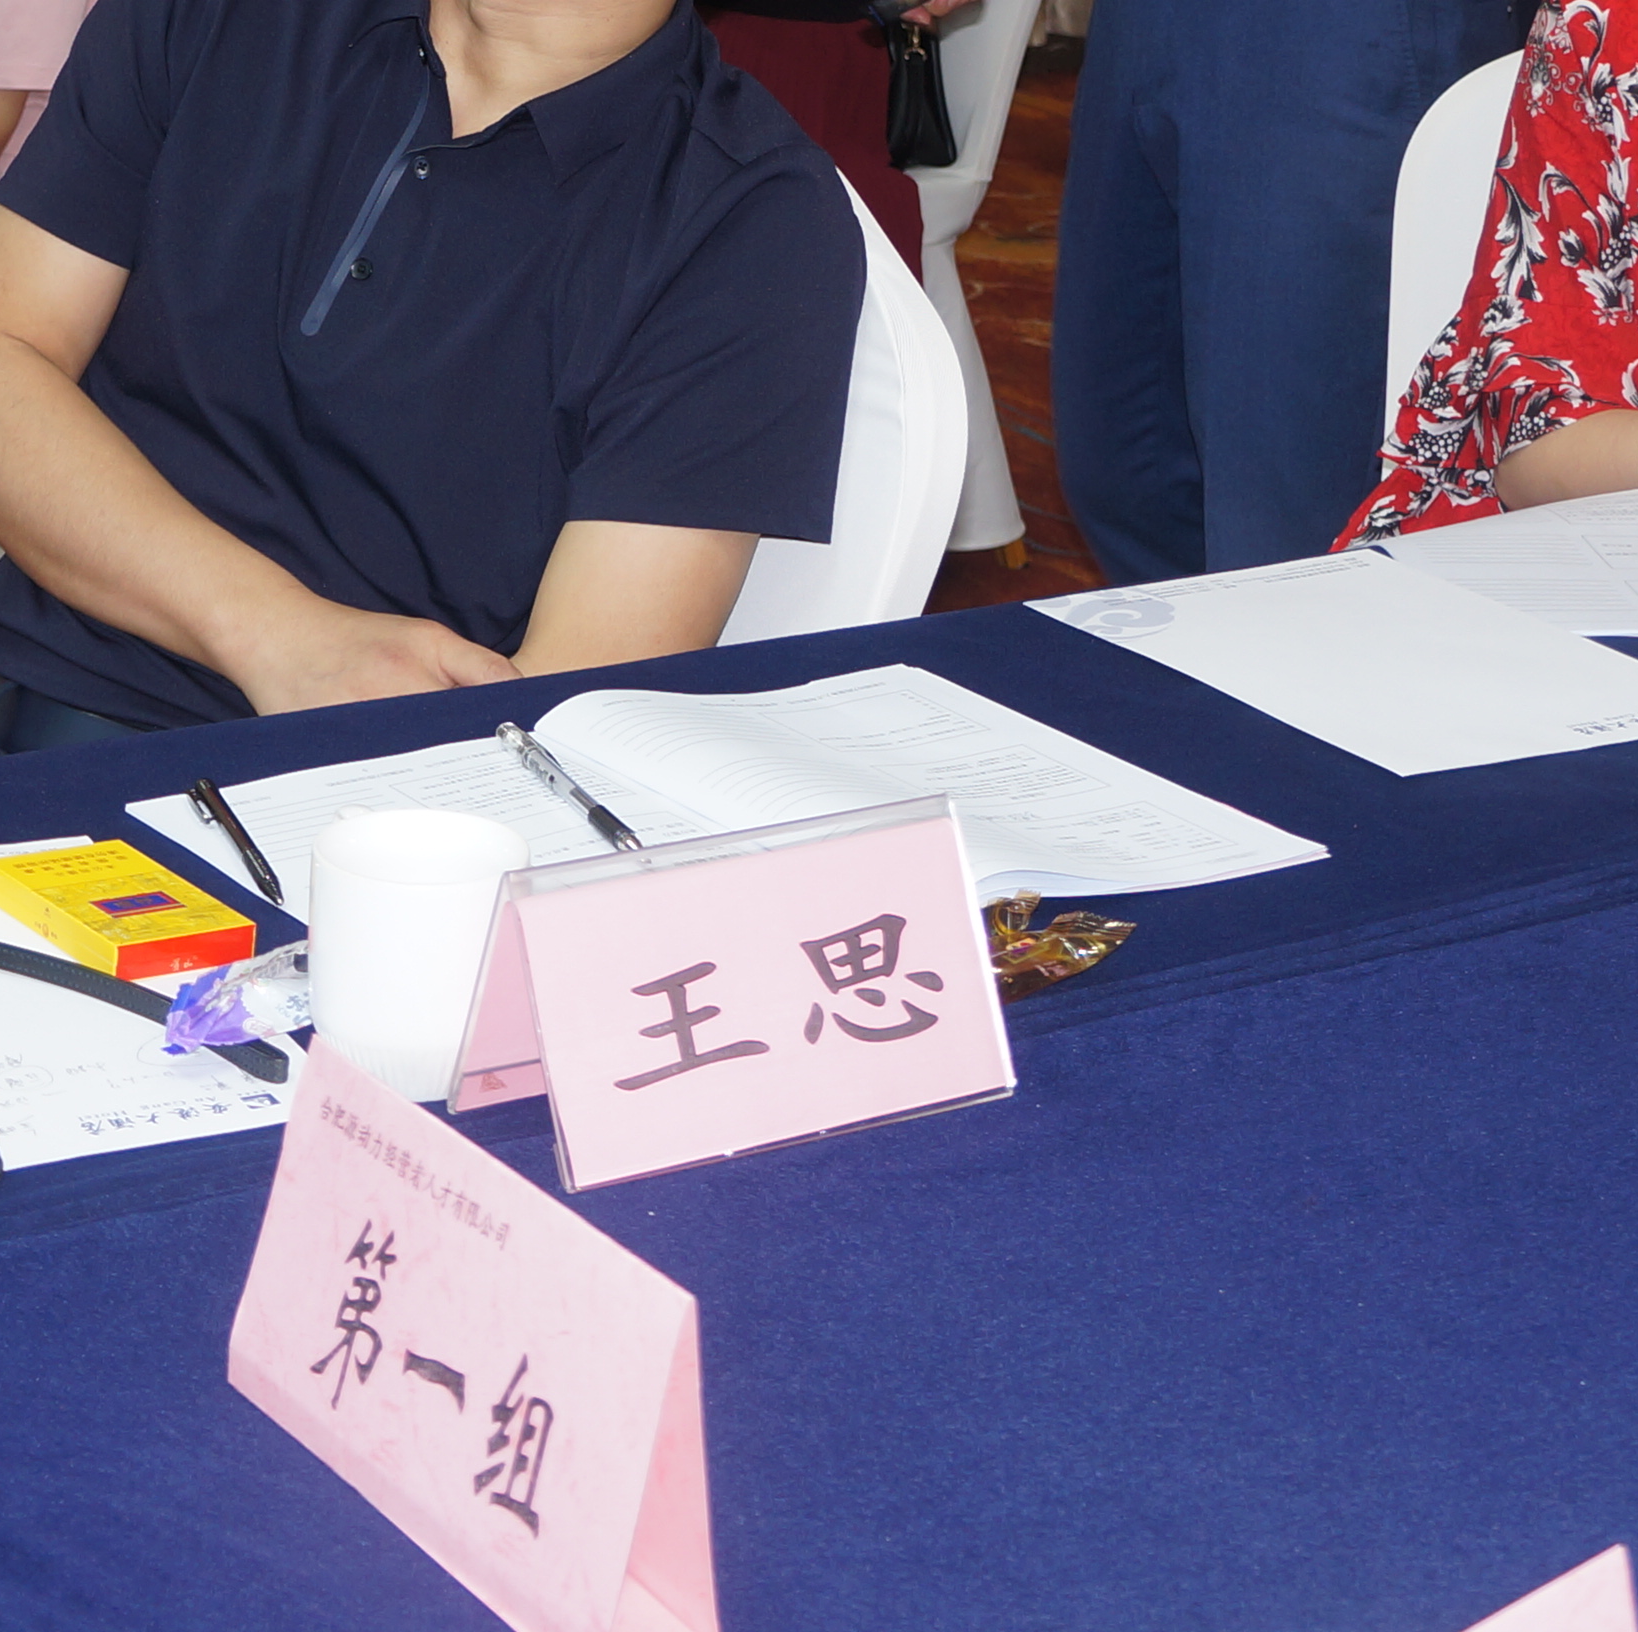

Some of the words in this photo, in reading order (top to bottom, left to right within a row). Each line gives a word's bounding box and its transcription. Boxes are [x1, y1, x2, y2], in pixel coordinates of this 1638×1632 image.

[612, 912, 946, 1092] 王思
[80, 1100, 232, 1136] 安港大酒店
[308, 1218, 557, 1540] 第一组
